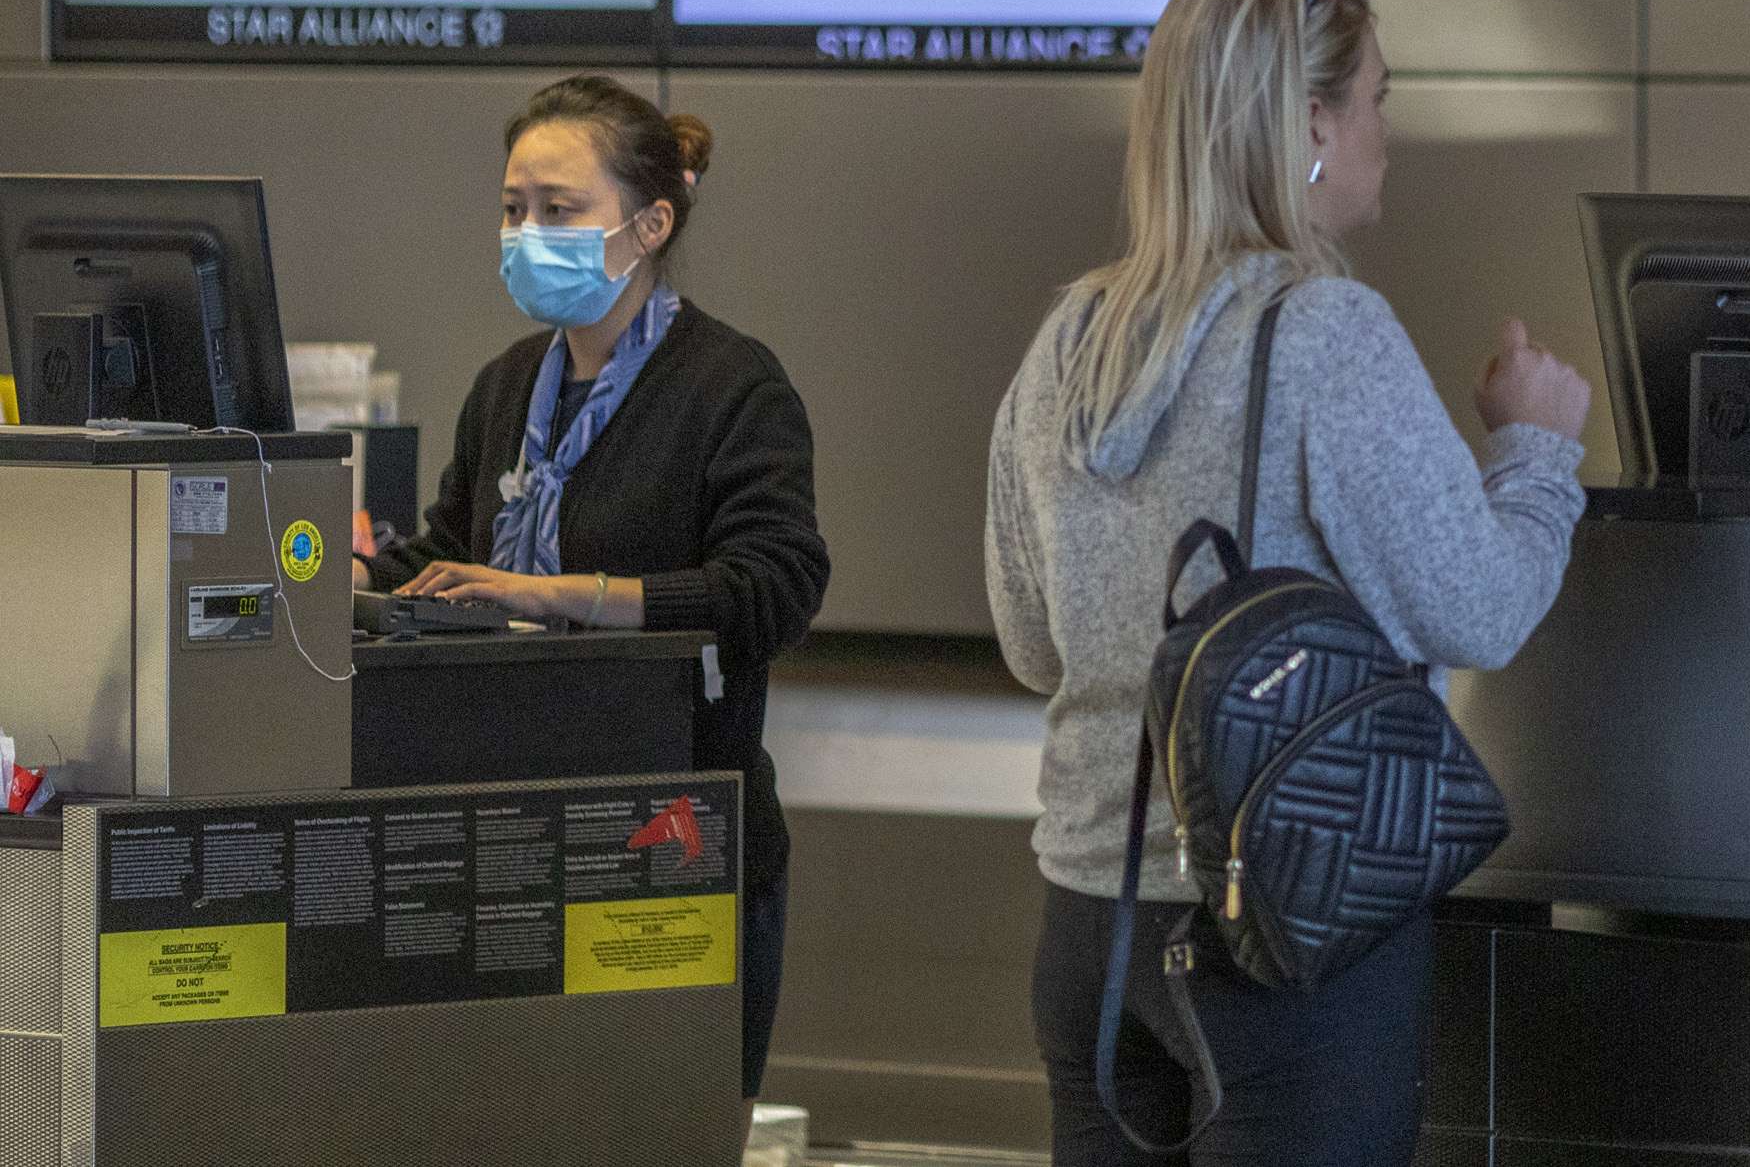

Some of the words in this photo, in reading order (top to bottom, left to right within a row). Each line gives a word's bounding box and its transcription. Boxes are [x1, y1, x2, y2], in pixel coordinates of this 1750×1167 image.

[206, 6, 294, 46] STAR
[300, 6, 467, 47] ALLIANCE
[815, 24, 916, 61] STAR
[161, 943, 194, 954] SECURITY
[194, 941, 219, 952] NOTICE
[176, 978, 187, 987] DO
[188, 977, 204, 987] NOT
